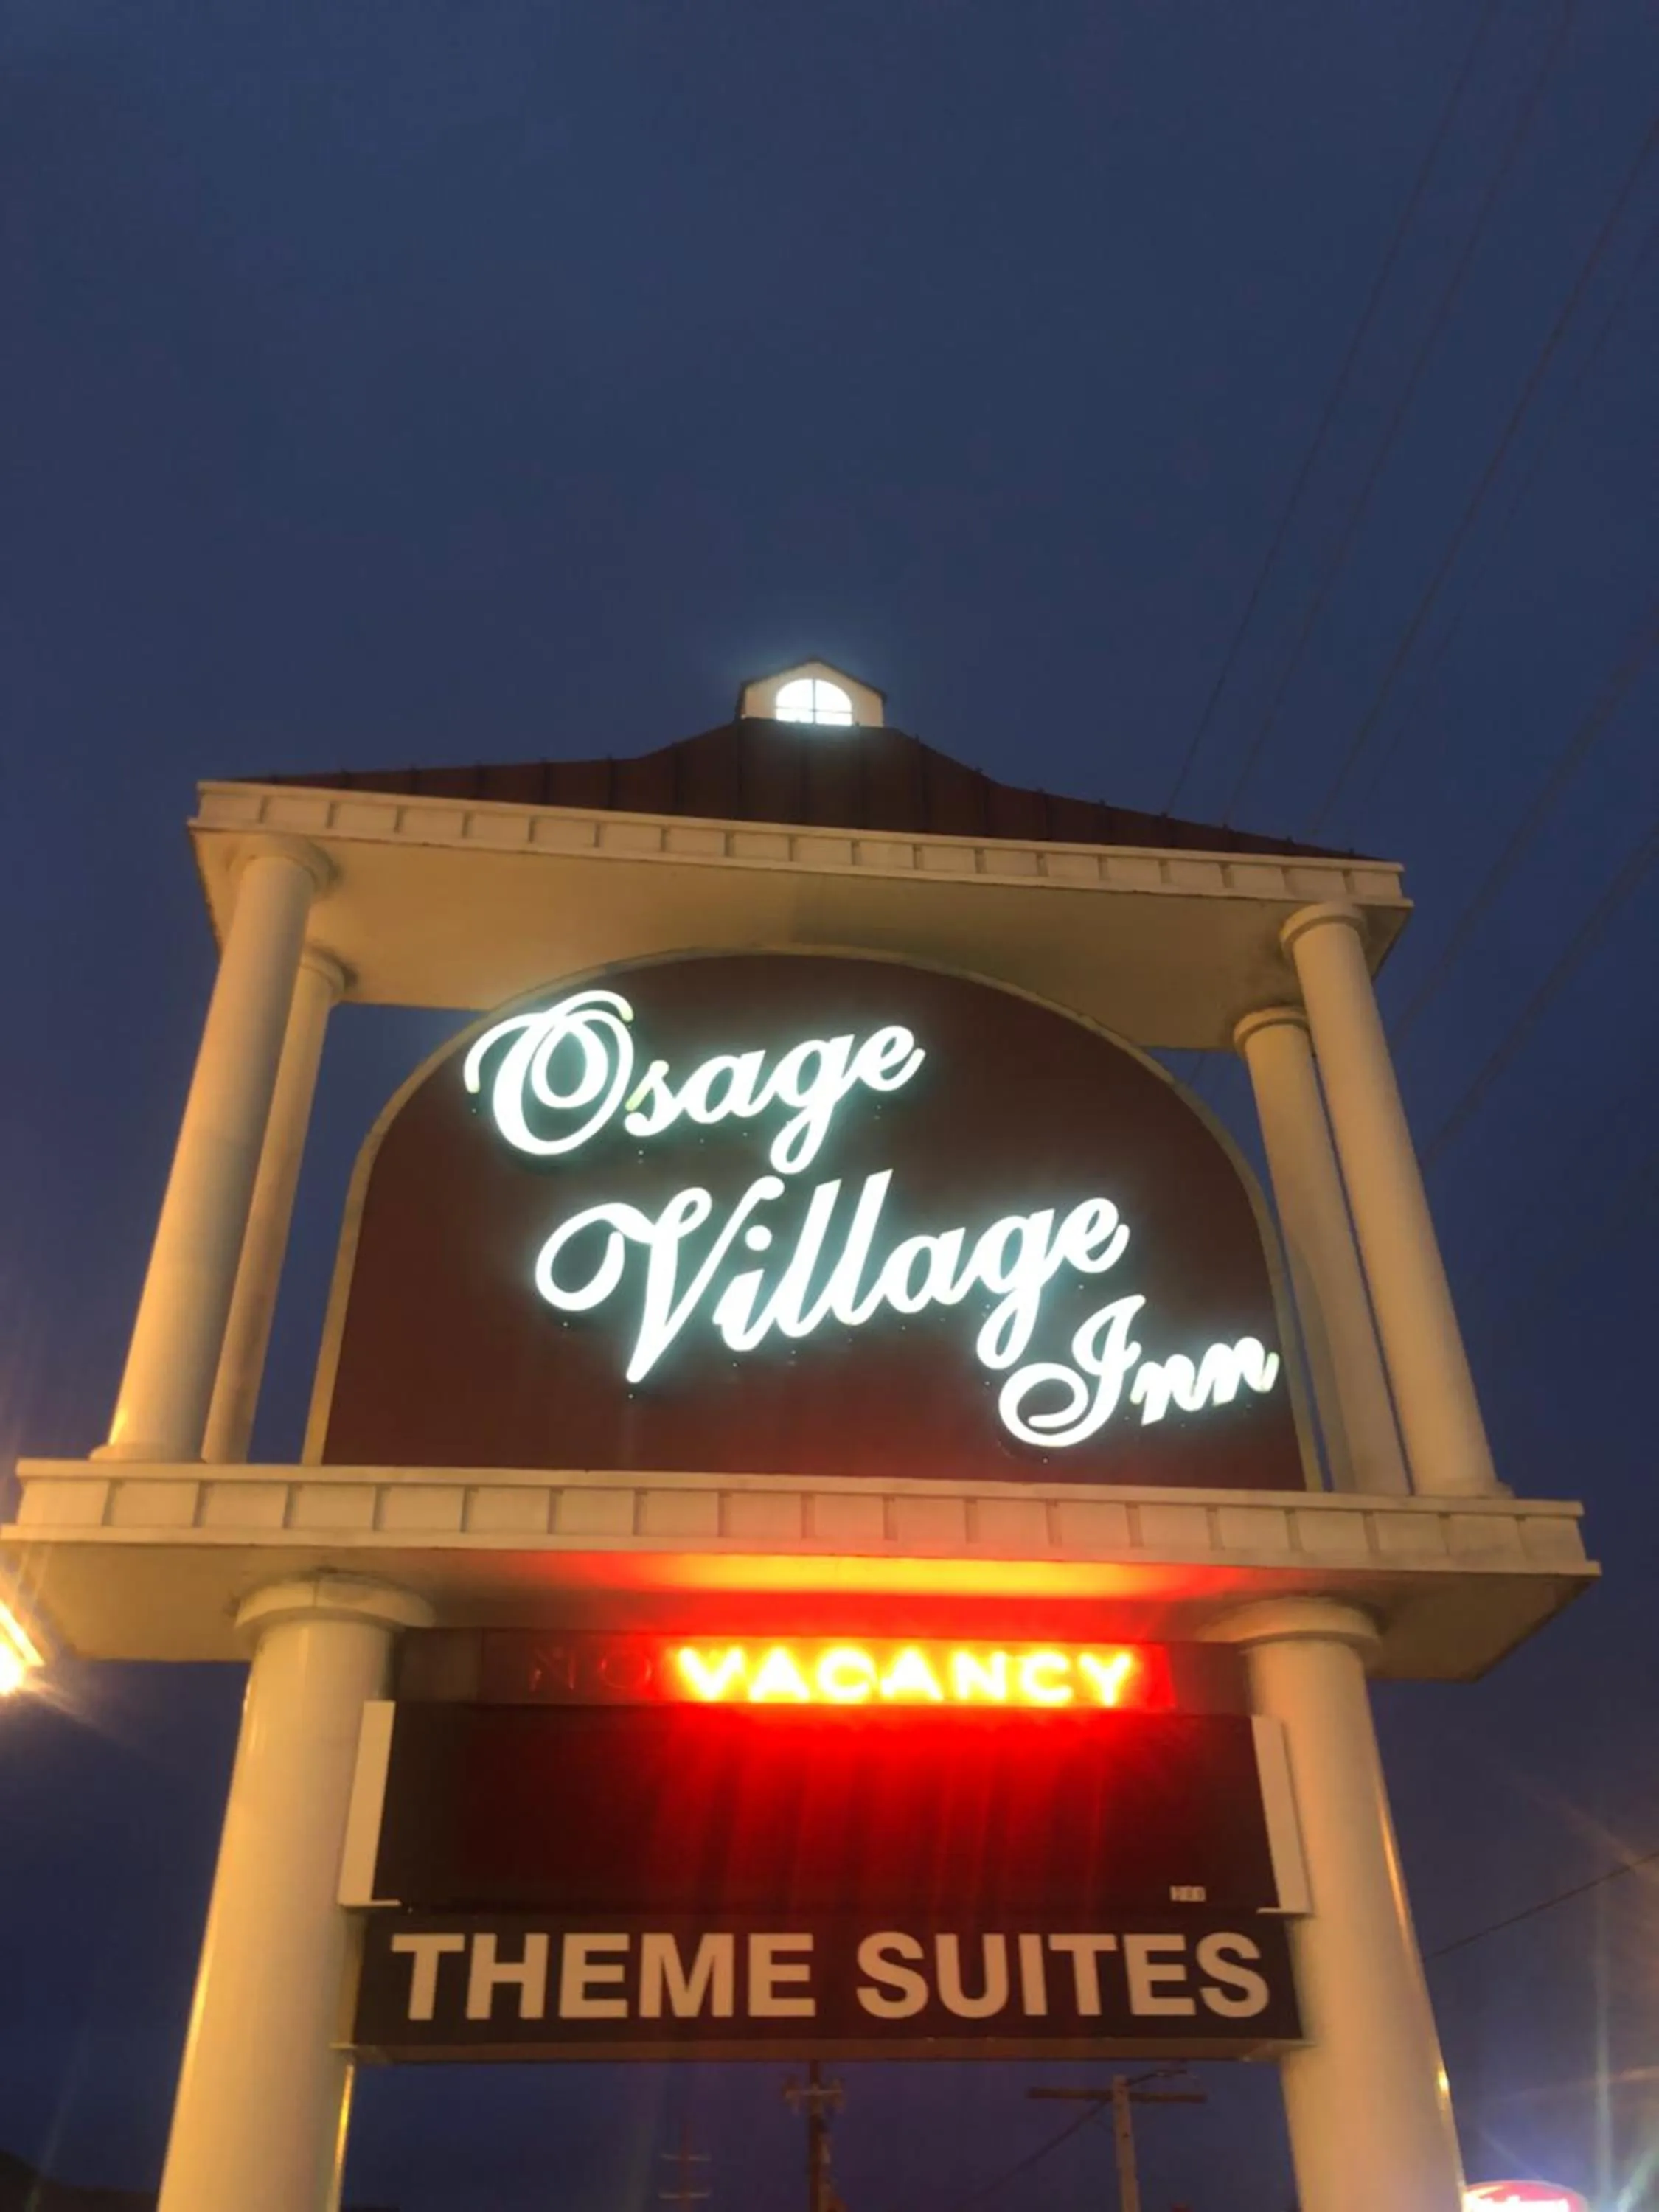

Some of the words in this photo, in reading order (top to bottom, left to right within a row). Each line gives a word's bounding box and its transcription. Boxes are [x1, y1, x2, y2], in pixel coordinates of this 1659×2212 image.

[465, 990, 925, 1174] Osage
[535, 1169, 1129, 1382] Village
[999, 1295, 1279, 1447] Inn
[529, 1647, 652, 1691] NO
[674, 1644, 1136, 1707] VACANCY
[391, 1933, 816, 2020] THEME
[856, 1930, 1270, 2020] SUITES
